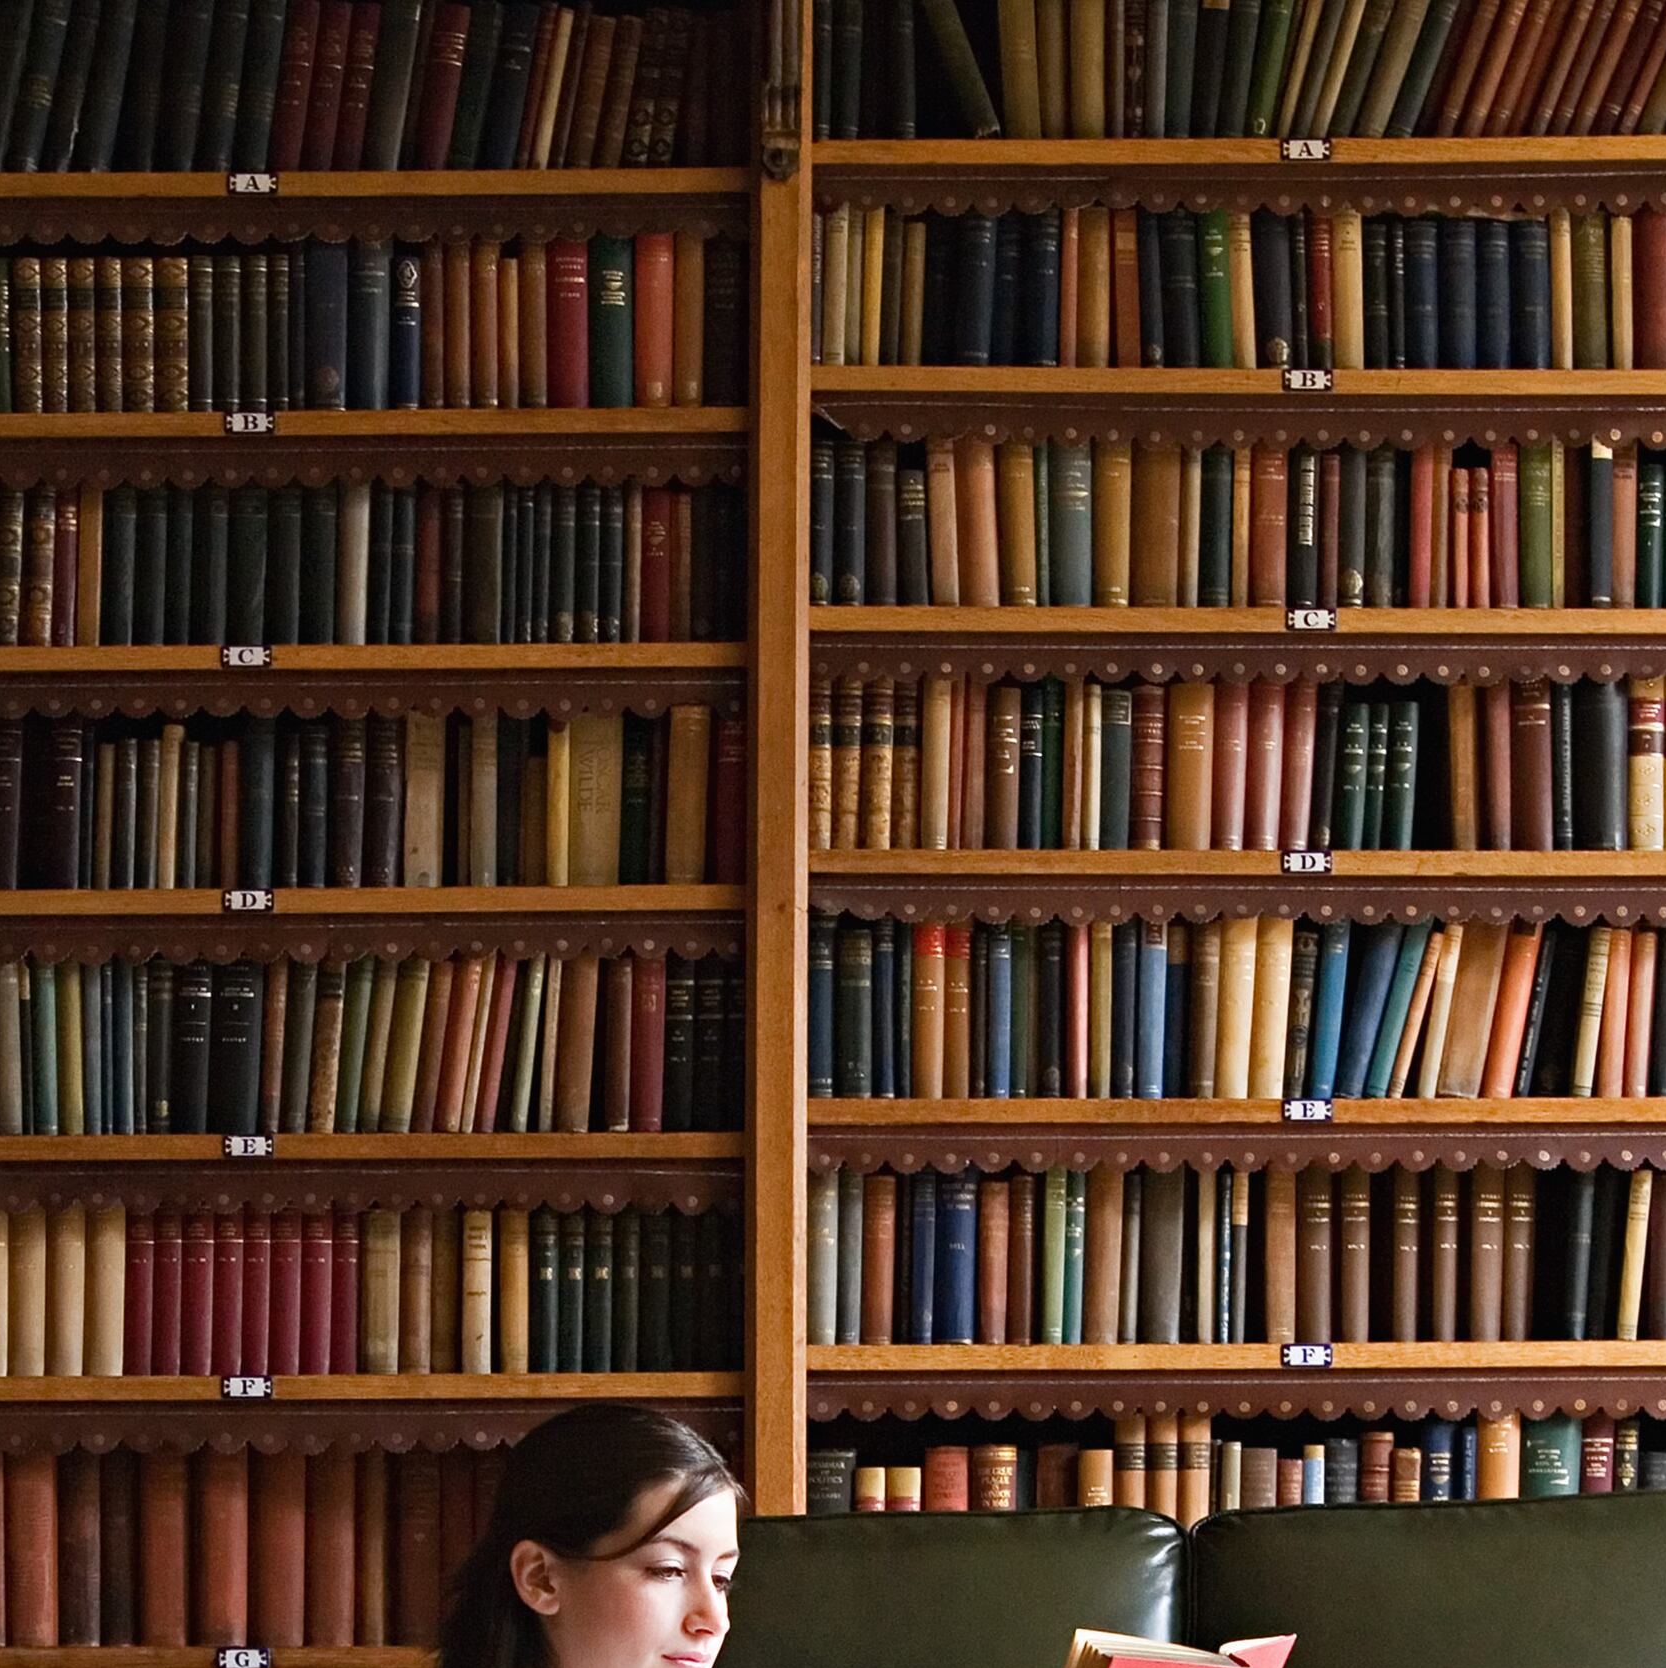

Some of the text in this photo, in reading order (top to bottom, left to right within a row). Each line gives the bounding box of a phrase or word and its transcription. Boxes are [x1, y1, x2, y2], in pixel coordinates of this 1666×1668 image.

[1299, 142, 1313, 156] A
[245, 176, 260, 190] A
[1300, 372, 1316, 386] B
[242, 415, 258, 430] B
[1304, 613, 1318, 626] C
[238, 650, 253, 663] C
[579, 748, 594, 810] WILDE
[1301, 855, 1316, 869] D
[241, 893, 257, 907] D
[1302, 1103, 1315, 1117] E
[242, 1139, 256, 1153] E
[1302, 1349, 1315, 1363] F
[241, 1380, 255, 1394] F
[235, 1652, 249, 1667] G
